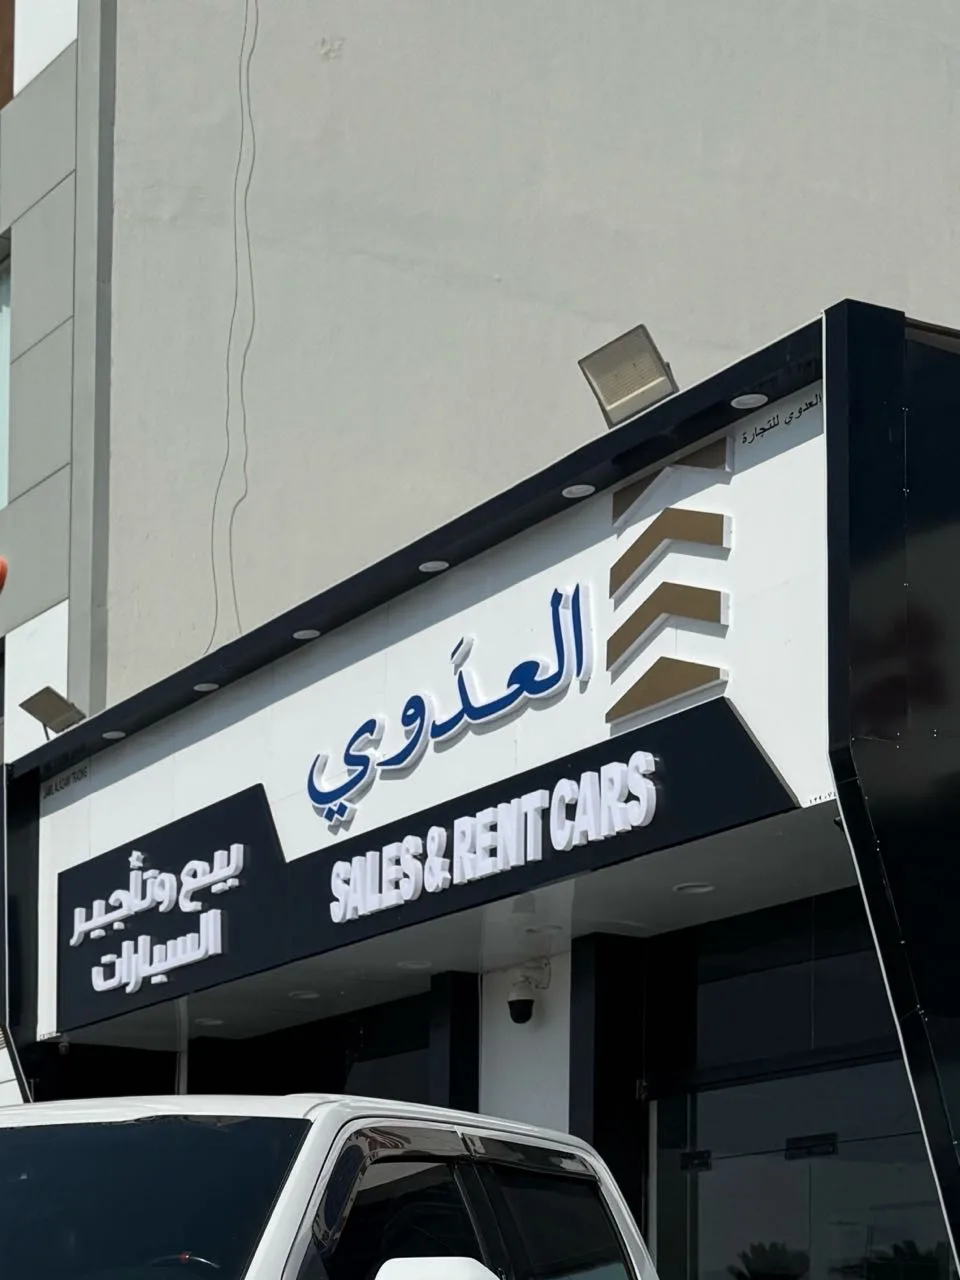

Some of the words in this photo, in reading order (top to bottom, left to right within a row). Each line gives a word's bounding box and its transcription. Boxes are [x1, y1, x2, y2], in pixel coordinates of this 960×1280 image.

[742, 414, 780, 444] للتجارة
[453, 789, 549, 885] RENT
[549, 751, 657, 851] CARS
[178, 843, 244, 912] بيع
[91, 908, 222, 993] السيارات
